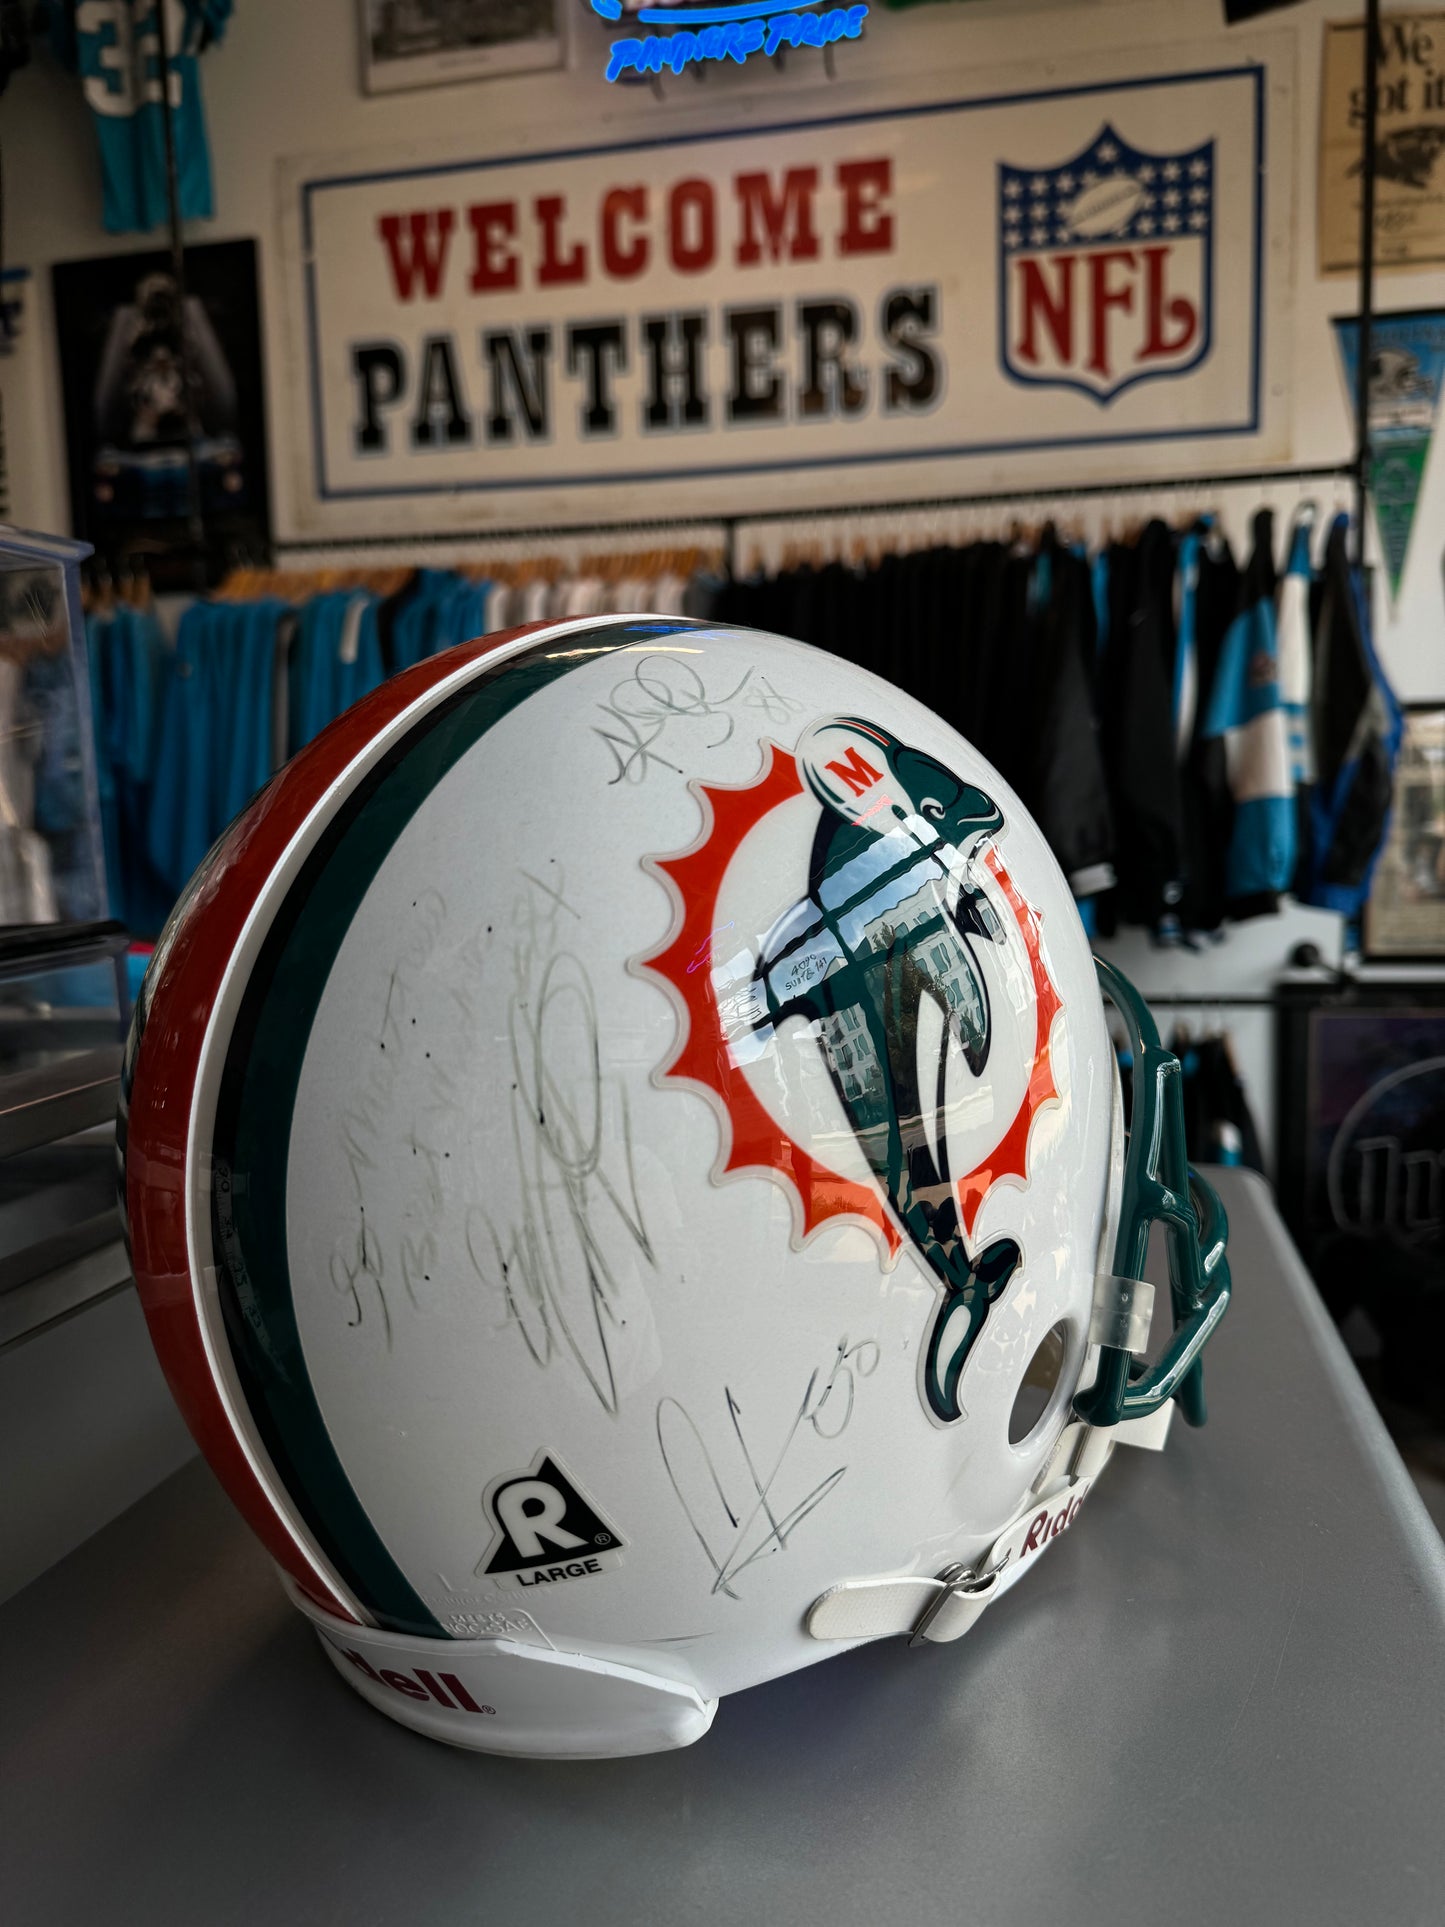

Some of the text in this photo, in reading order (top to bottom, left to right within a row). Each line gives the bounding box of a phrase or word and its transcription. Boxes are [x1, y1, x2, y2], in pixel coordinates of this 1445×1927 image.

[376, 155, 895, 304] WELCOME
[1017, 247, 1197, 380] NFL
[351, 284, 946, 456] PANTHERS
[824, 747, 884, 798] M
[498, 1480, 590, 1558] R
[516, 1558, 603, 1587] LARGE
